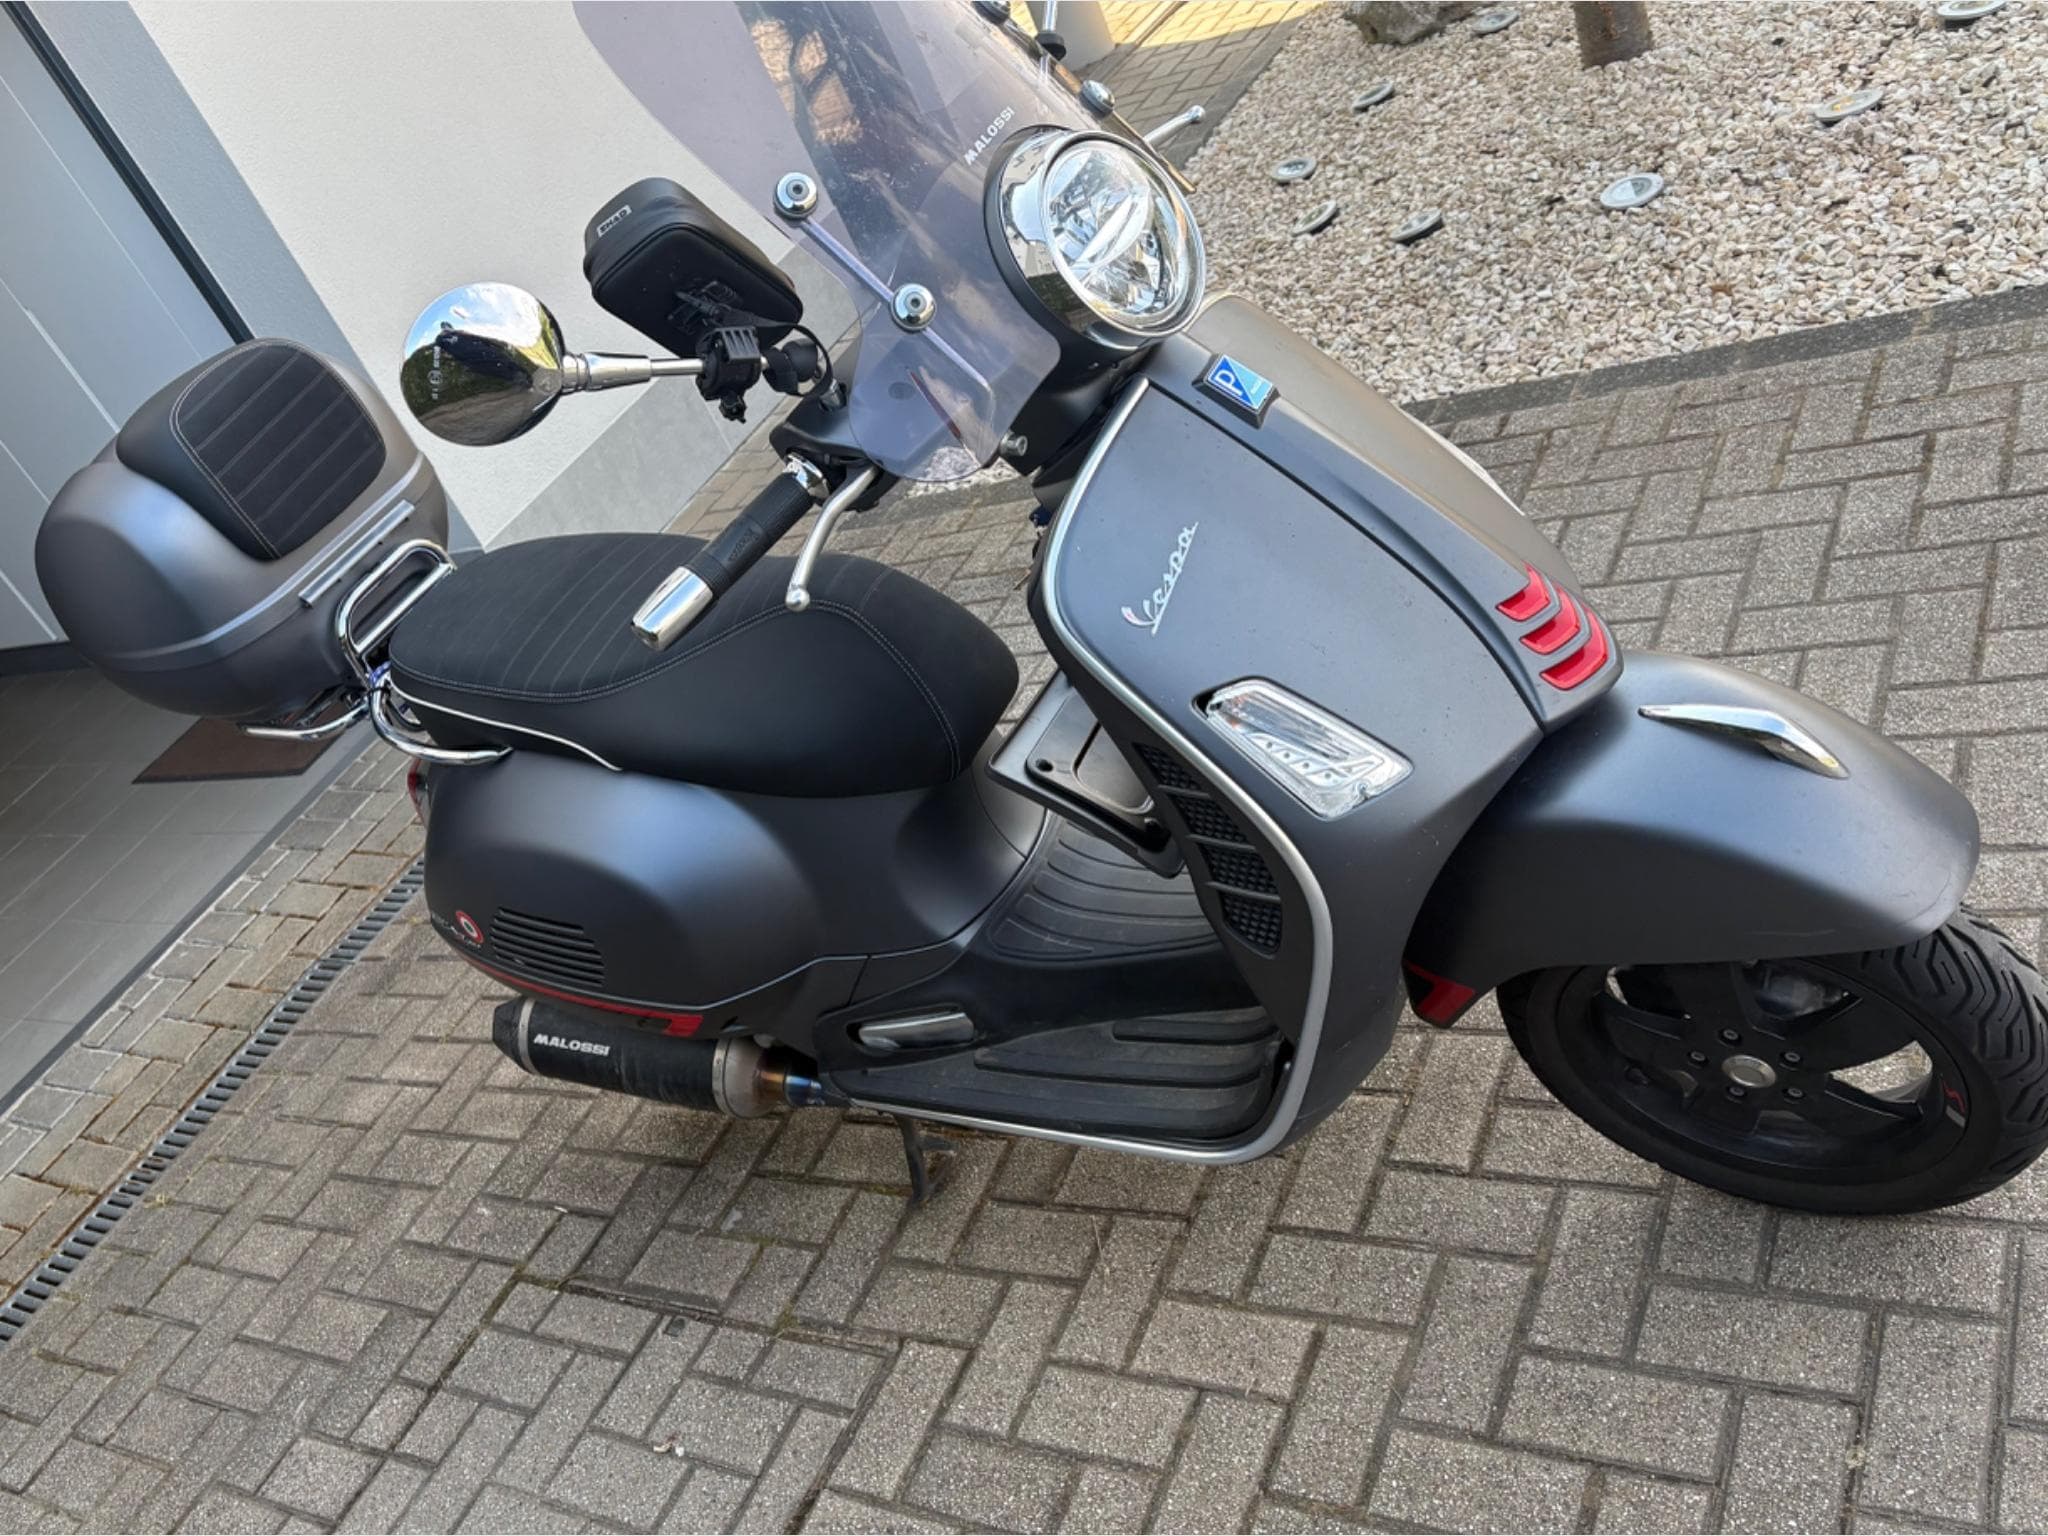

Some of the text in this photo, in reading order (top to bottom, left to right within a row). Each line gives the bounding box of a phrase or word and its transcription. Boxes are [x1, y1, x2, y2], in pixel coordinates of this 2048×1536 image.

[964, 106, 1015, 166] MALOSSI
[1213, 369, 1244, 396] P
[1121, 521, 1199, 636] Vespa
[533, 1033, 611, 1057] MALOSSI
